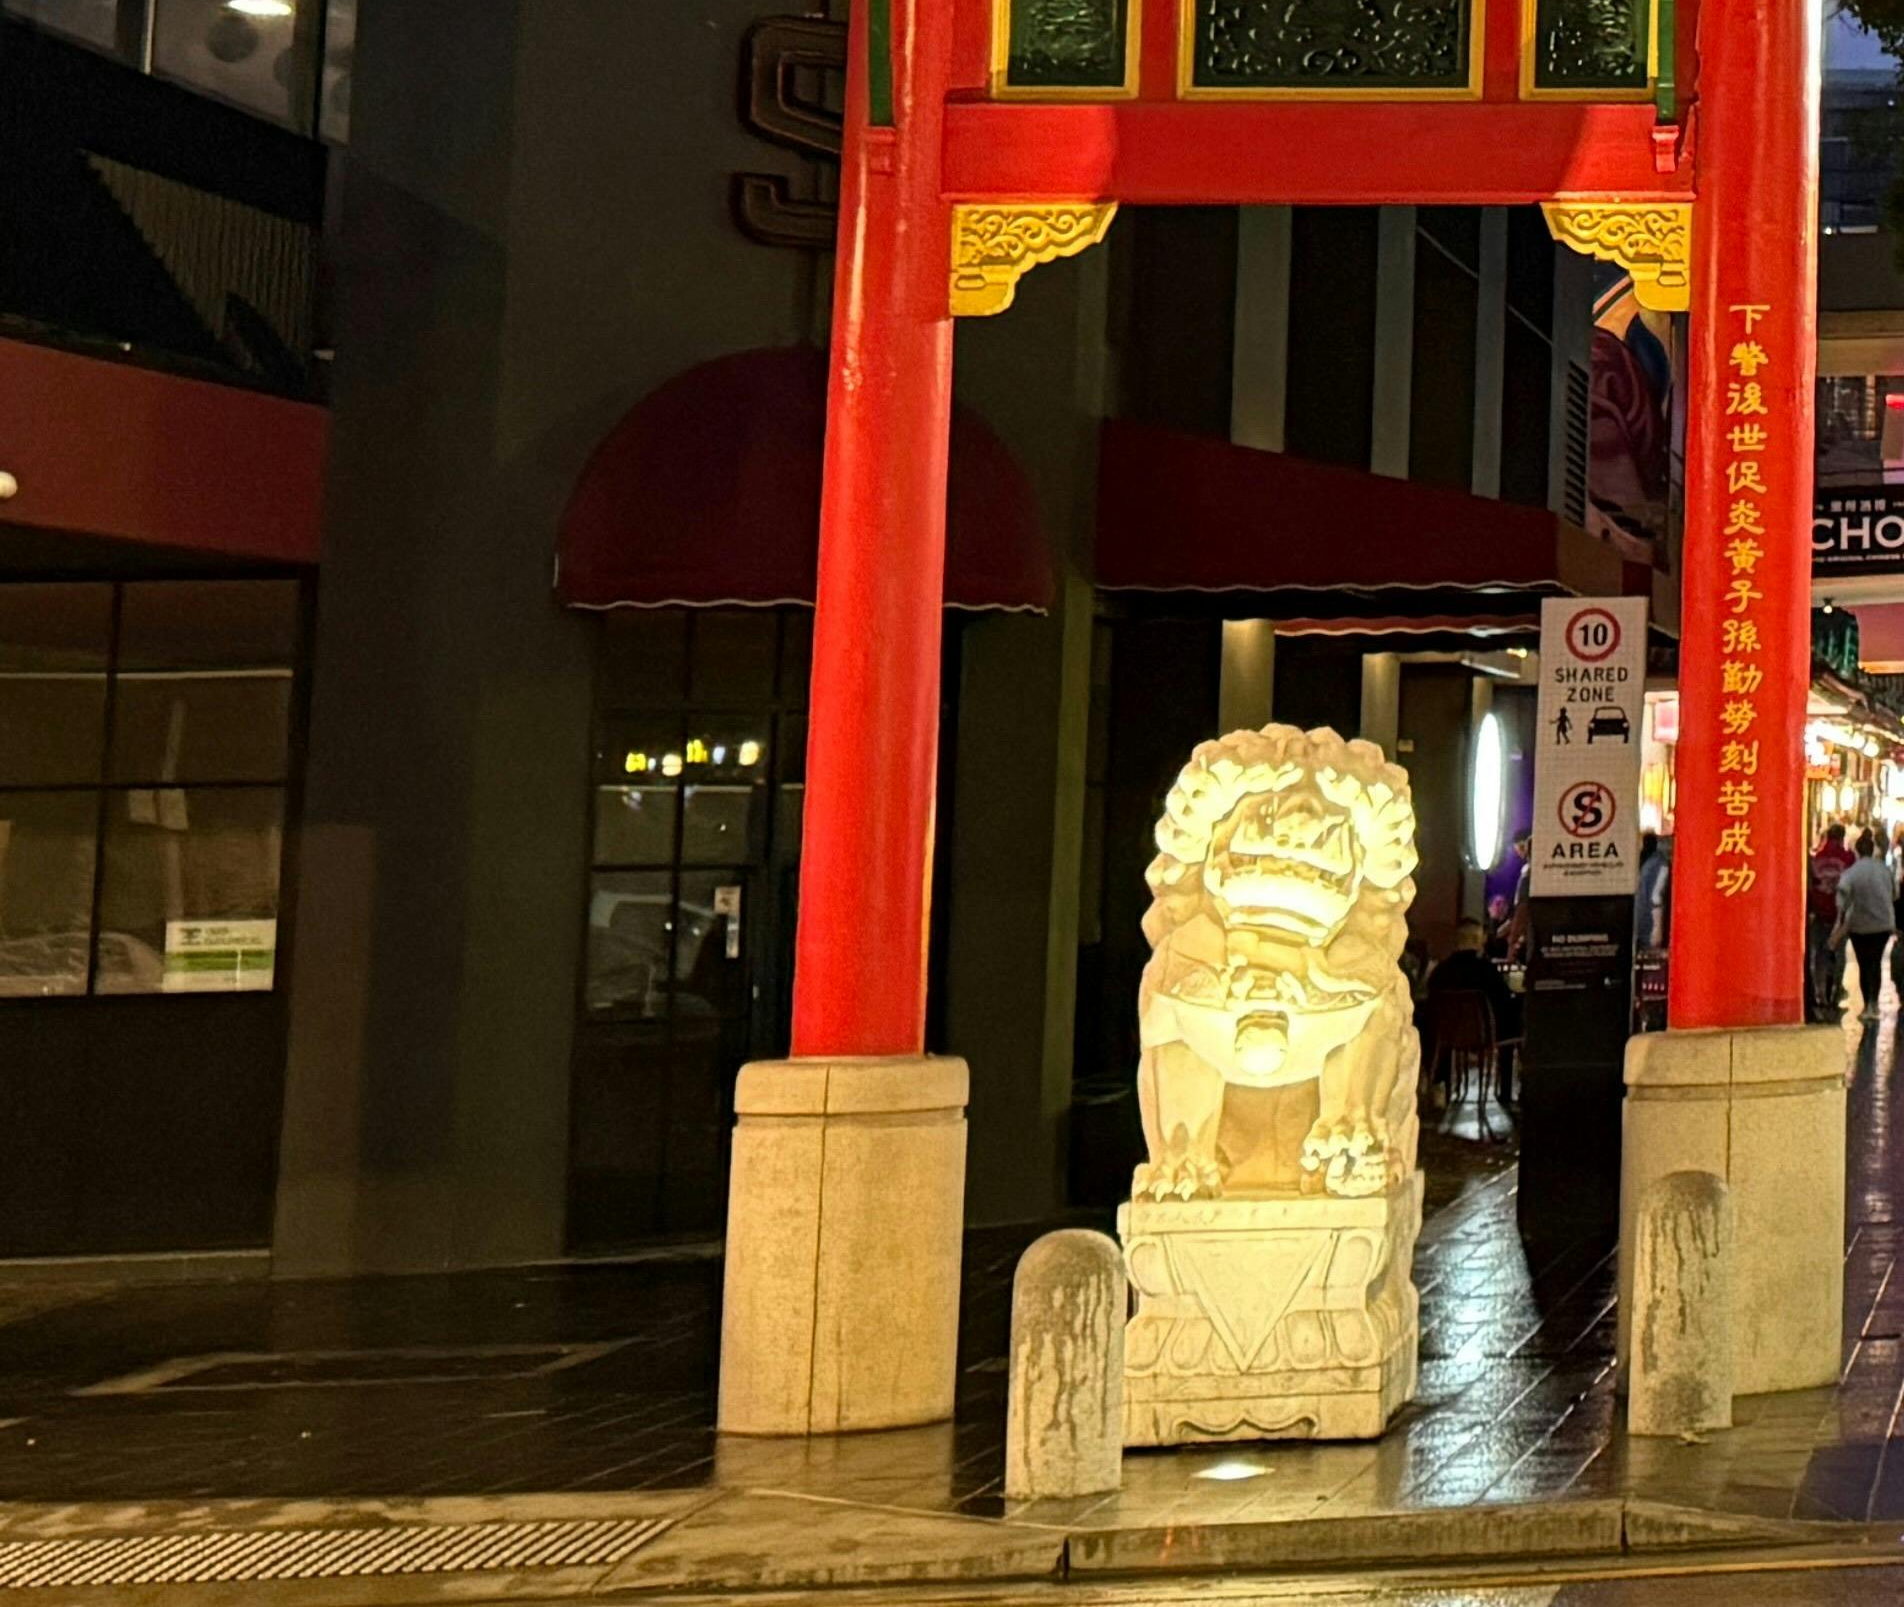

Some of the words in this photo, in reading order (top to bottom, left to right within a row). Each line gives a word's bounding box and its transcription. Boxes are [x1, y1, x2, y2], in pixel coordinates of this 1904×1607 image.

[1578, 622, 1609, 647] 10
[1554, 666, 1629, 684] SHARED
[1566, 685, 1616, 703] ZONE
[1571, 790, 1603, 828] S
[1551, 842, 1620, 859] AREA
